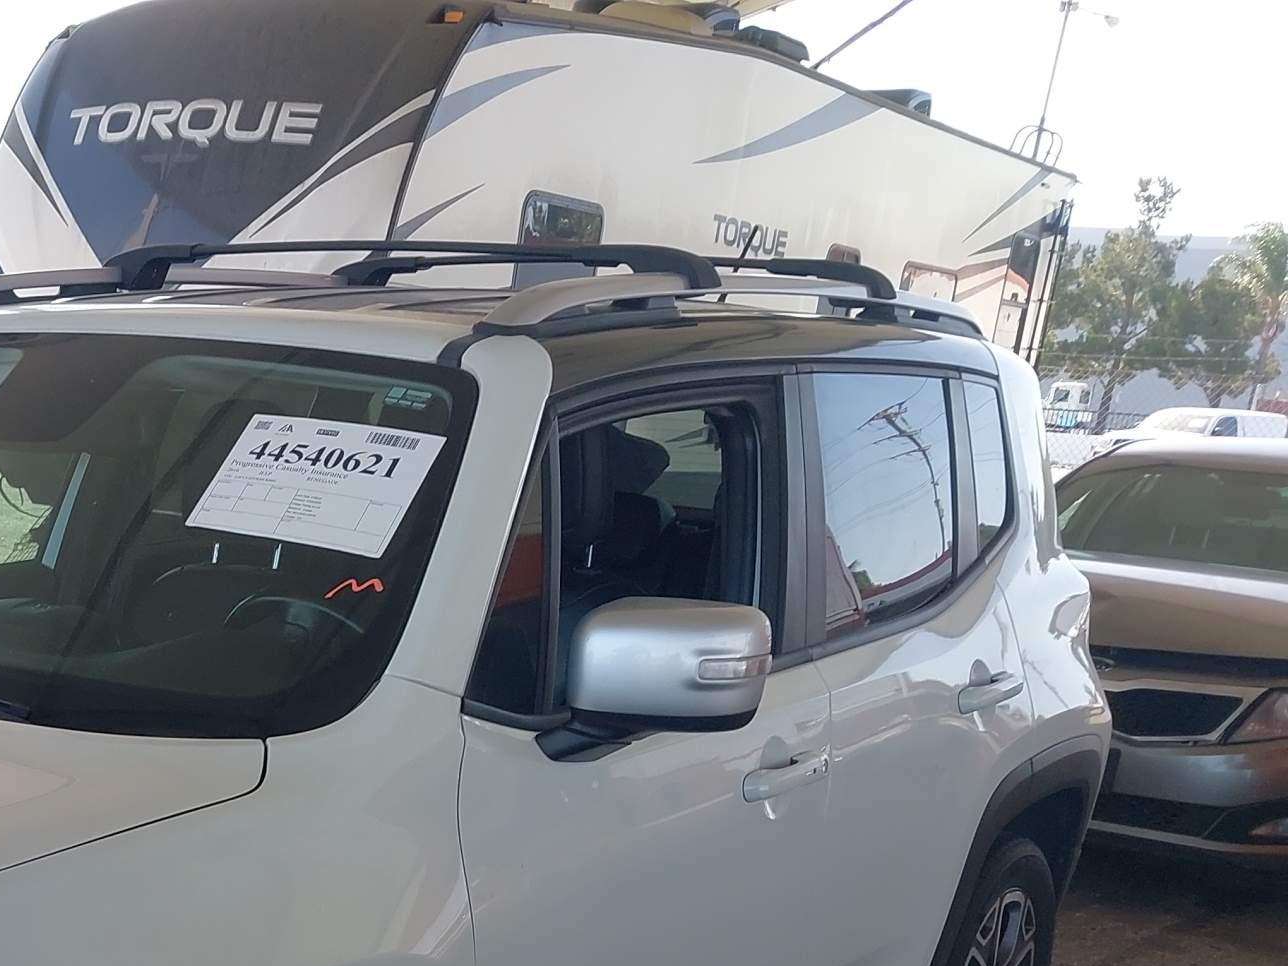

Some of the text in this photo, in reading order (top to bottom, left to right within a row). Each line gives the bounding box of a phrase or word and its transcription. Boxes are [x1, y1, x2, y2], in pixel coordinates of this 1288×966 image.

[70, 99, 323, 147] TORQUE
[713, 213, 788, 257] TORQUE
[231, 459, 275, 470] Progressive
[275, 464, 309, 475] Casualty
[311, 468, 349, 479] Insurance
[248, 440, 401, 479] 44540621
